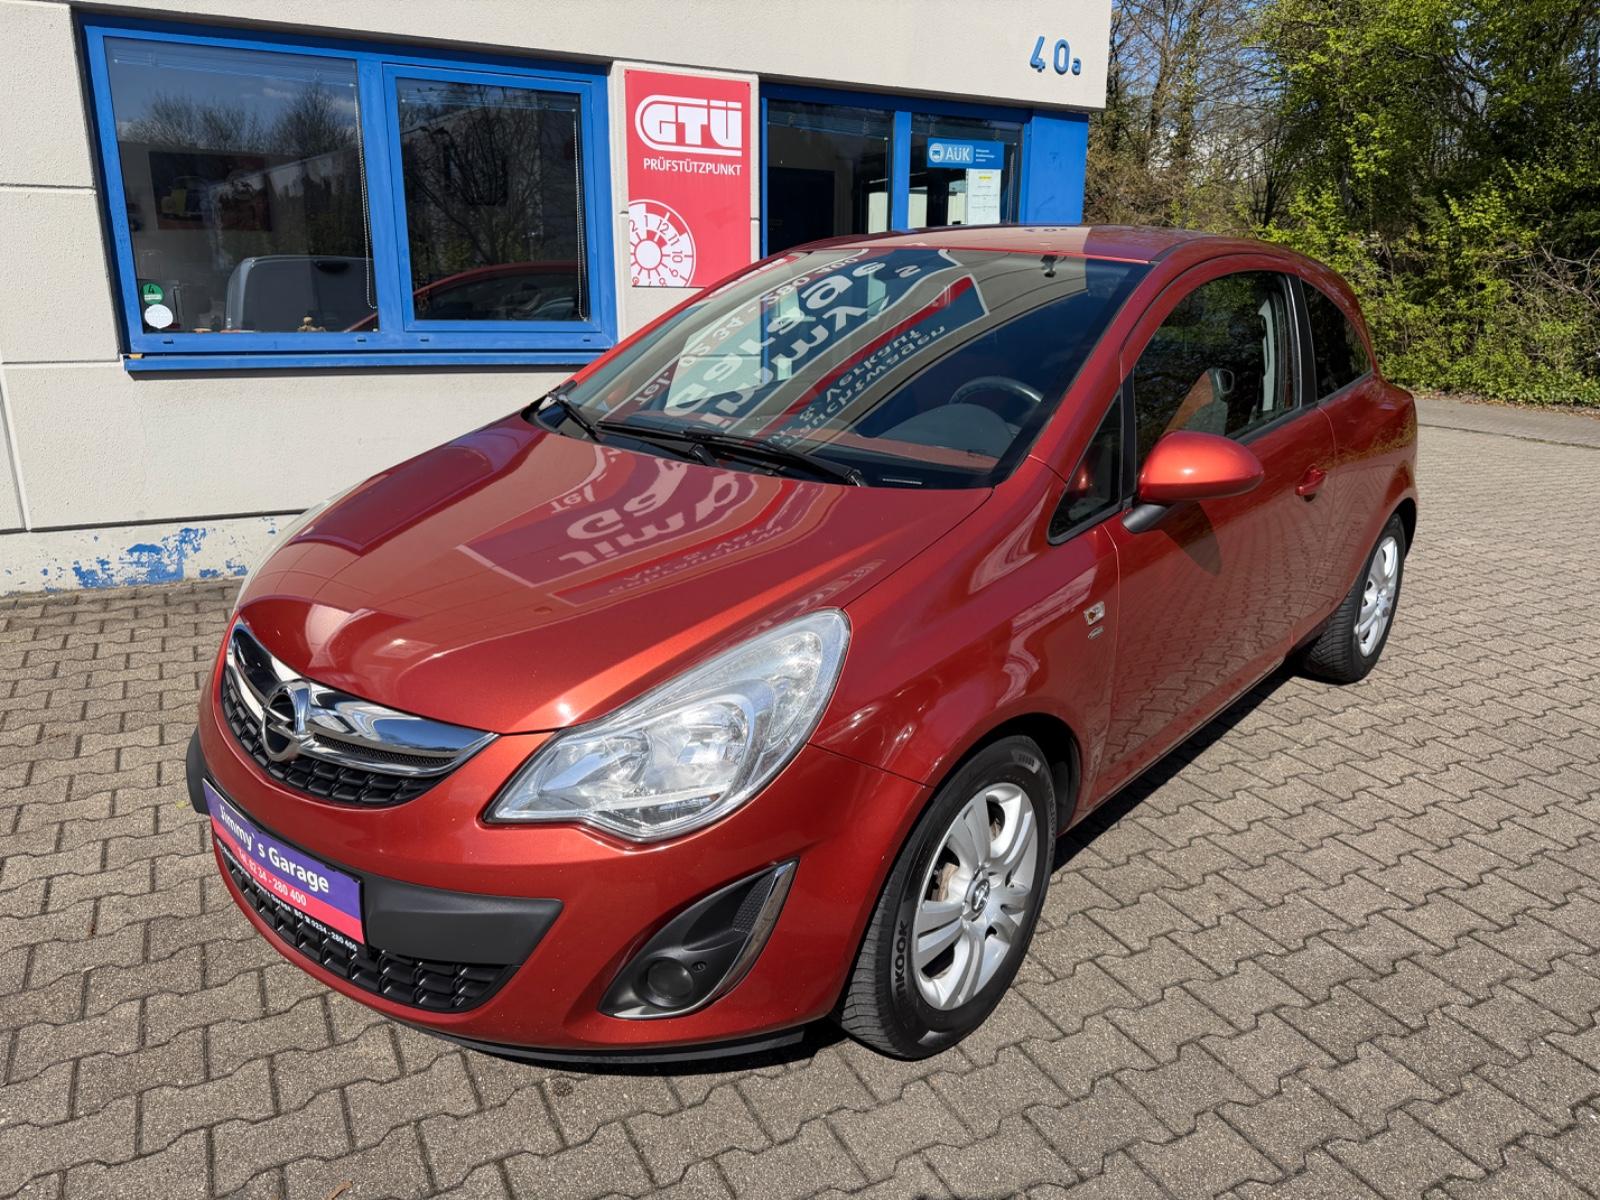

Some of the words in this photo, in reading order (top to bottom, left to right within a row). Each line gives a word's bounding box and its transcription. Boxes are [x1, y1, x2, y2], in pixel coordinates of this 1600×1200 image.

[1029, 36, 1082, 75] 40a
[639, 97, 742, 152] GTÜ
[643, 156, 742, 176] PRÜFSTÜTZPUNKT
[657, 218, 669, 235] 12
[668, 234, 680, 246] 11
[672, 251, 683, 263] 10
[268, 847, 329, 892] Garage
[273, 878, 288, 896] 280
[290, 886, 307, 906] 400
